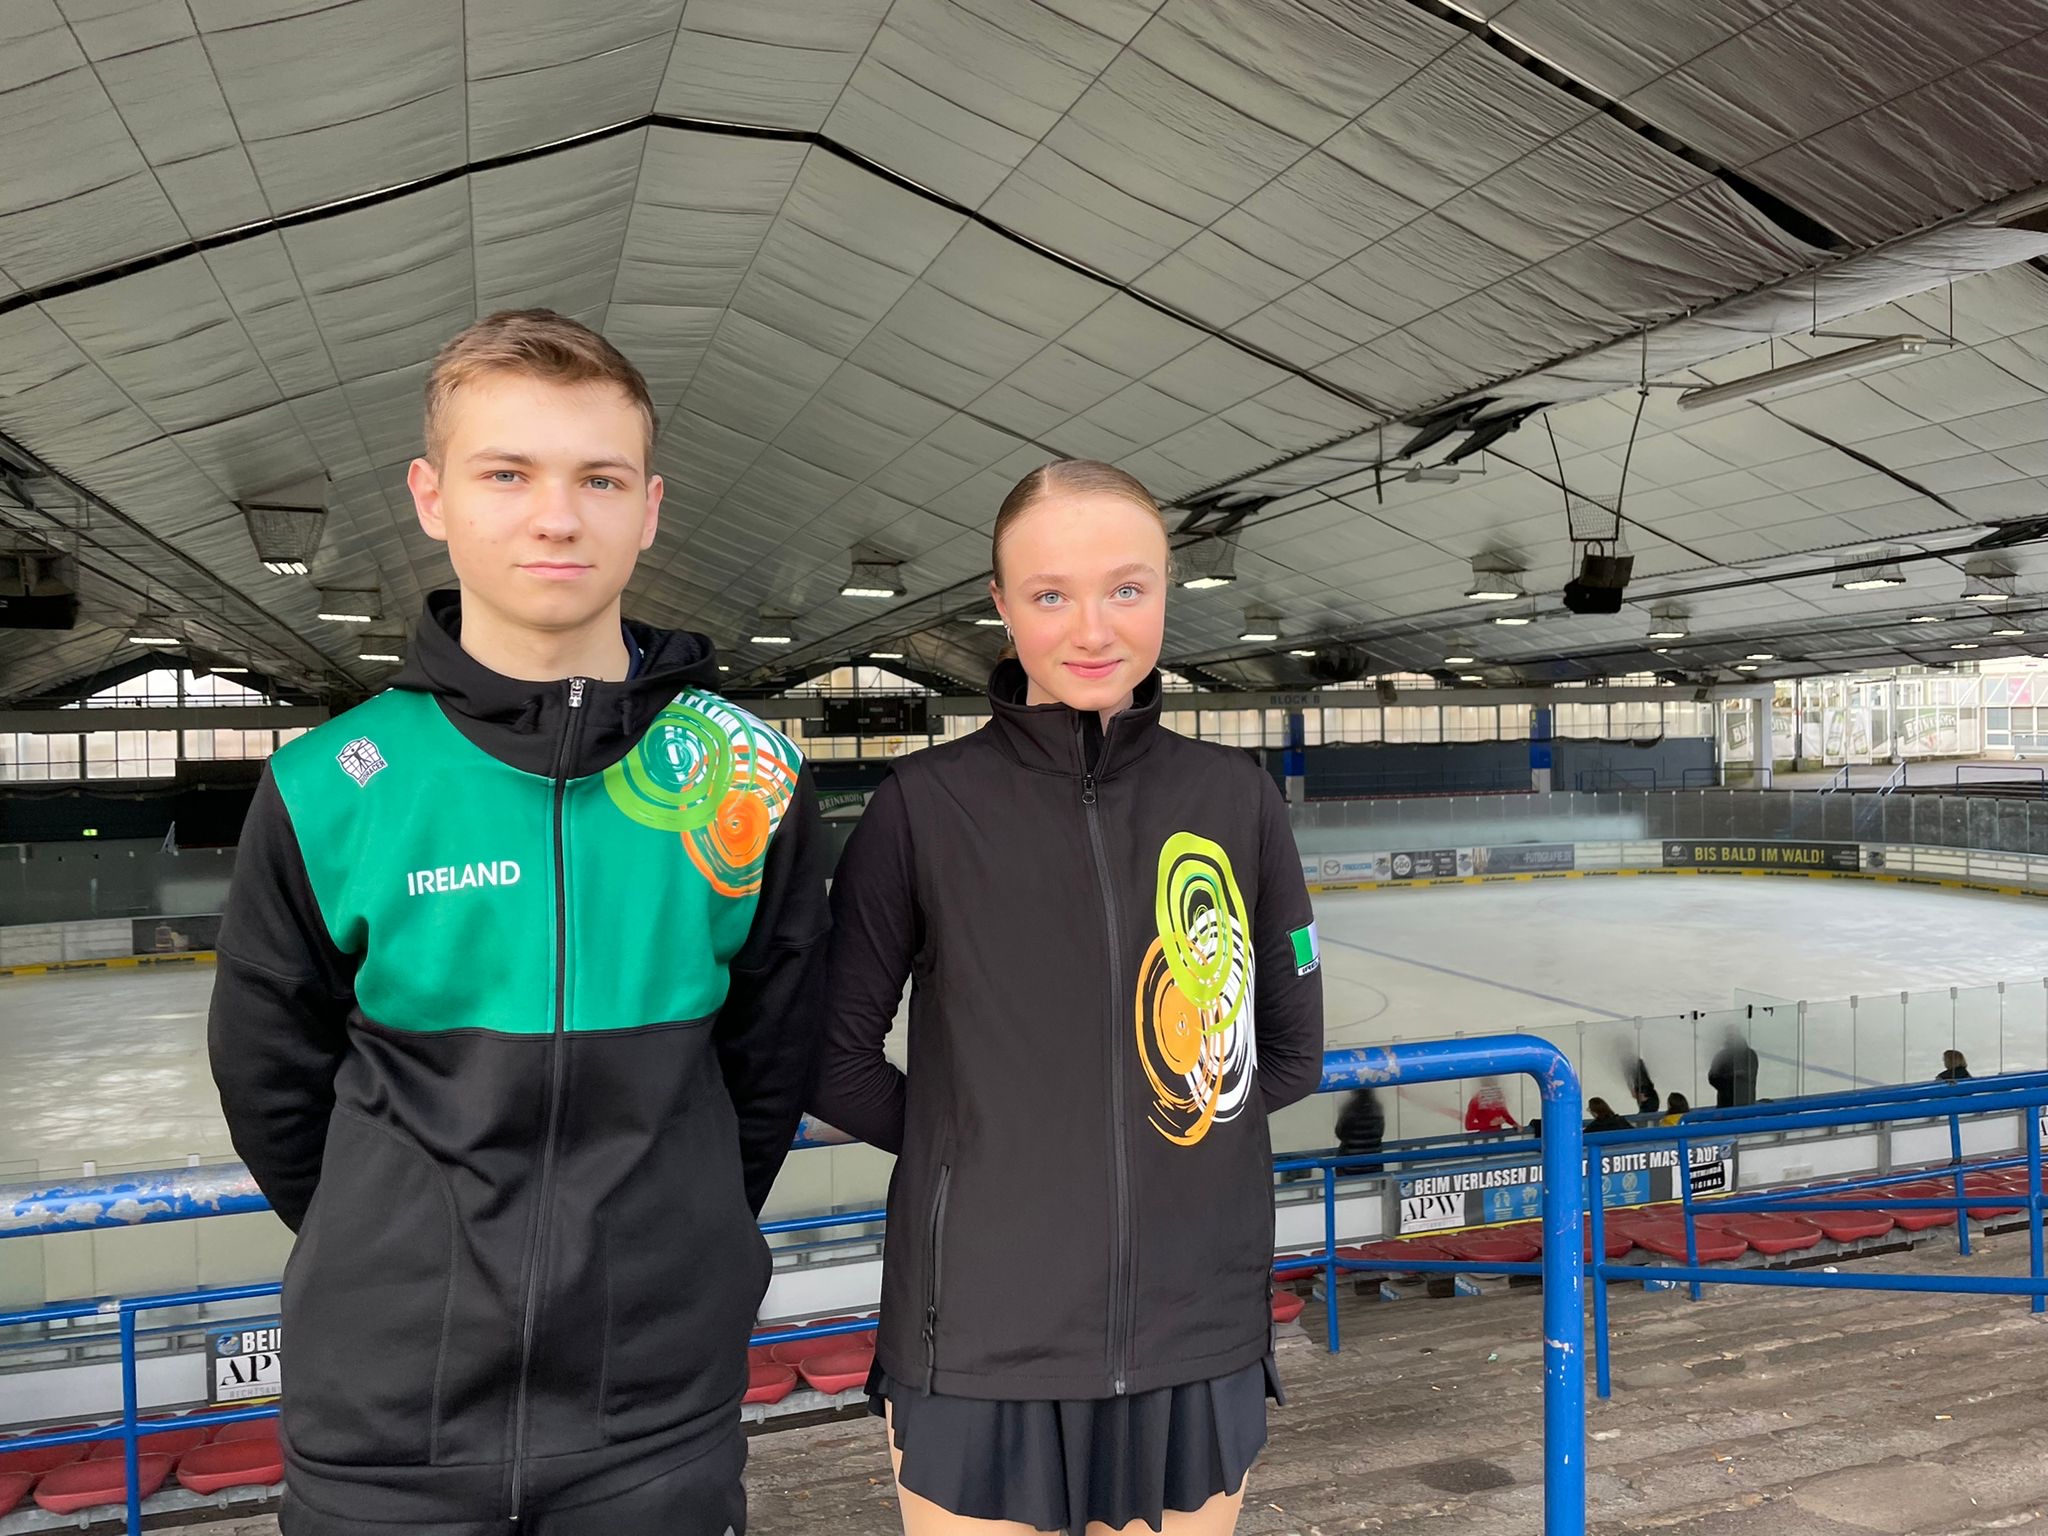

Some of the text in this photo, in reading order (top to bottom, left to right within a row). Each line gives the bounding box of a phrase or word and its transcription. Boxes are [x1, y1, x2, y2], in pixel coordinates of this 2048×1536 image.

[1695, 846, 1717, 861] BIS
[1721, 847, 1756, 862] BALD
[1761, 848, 1778, 862] IM
[1782, 848, 1825, 864] WALD!
[407, 860, 521, 896] IRELAND
[1414, 1175, 1450, 1196] BEIM
[1453, 1166, 1527, 1191] VERLASSEN
[1613, 1153, 1647, 1173] BITTE
[1650, 1148, 1694, 1169] MASE
[1696, 1146, 1719, 1163] AUF
[1403, 1194, 1462, 1223] APW
[220, 1353, 281, 1386] AP
[229, 1386, 281, 1399] RECHTSAN
